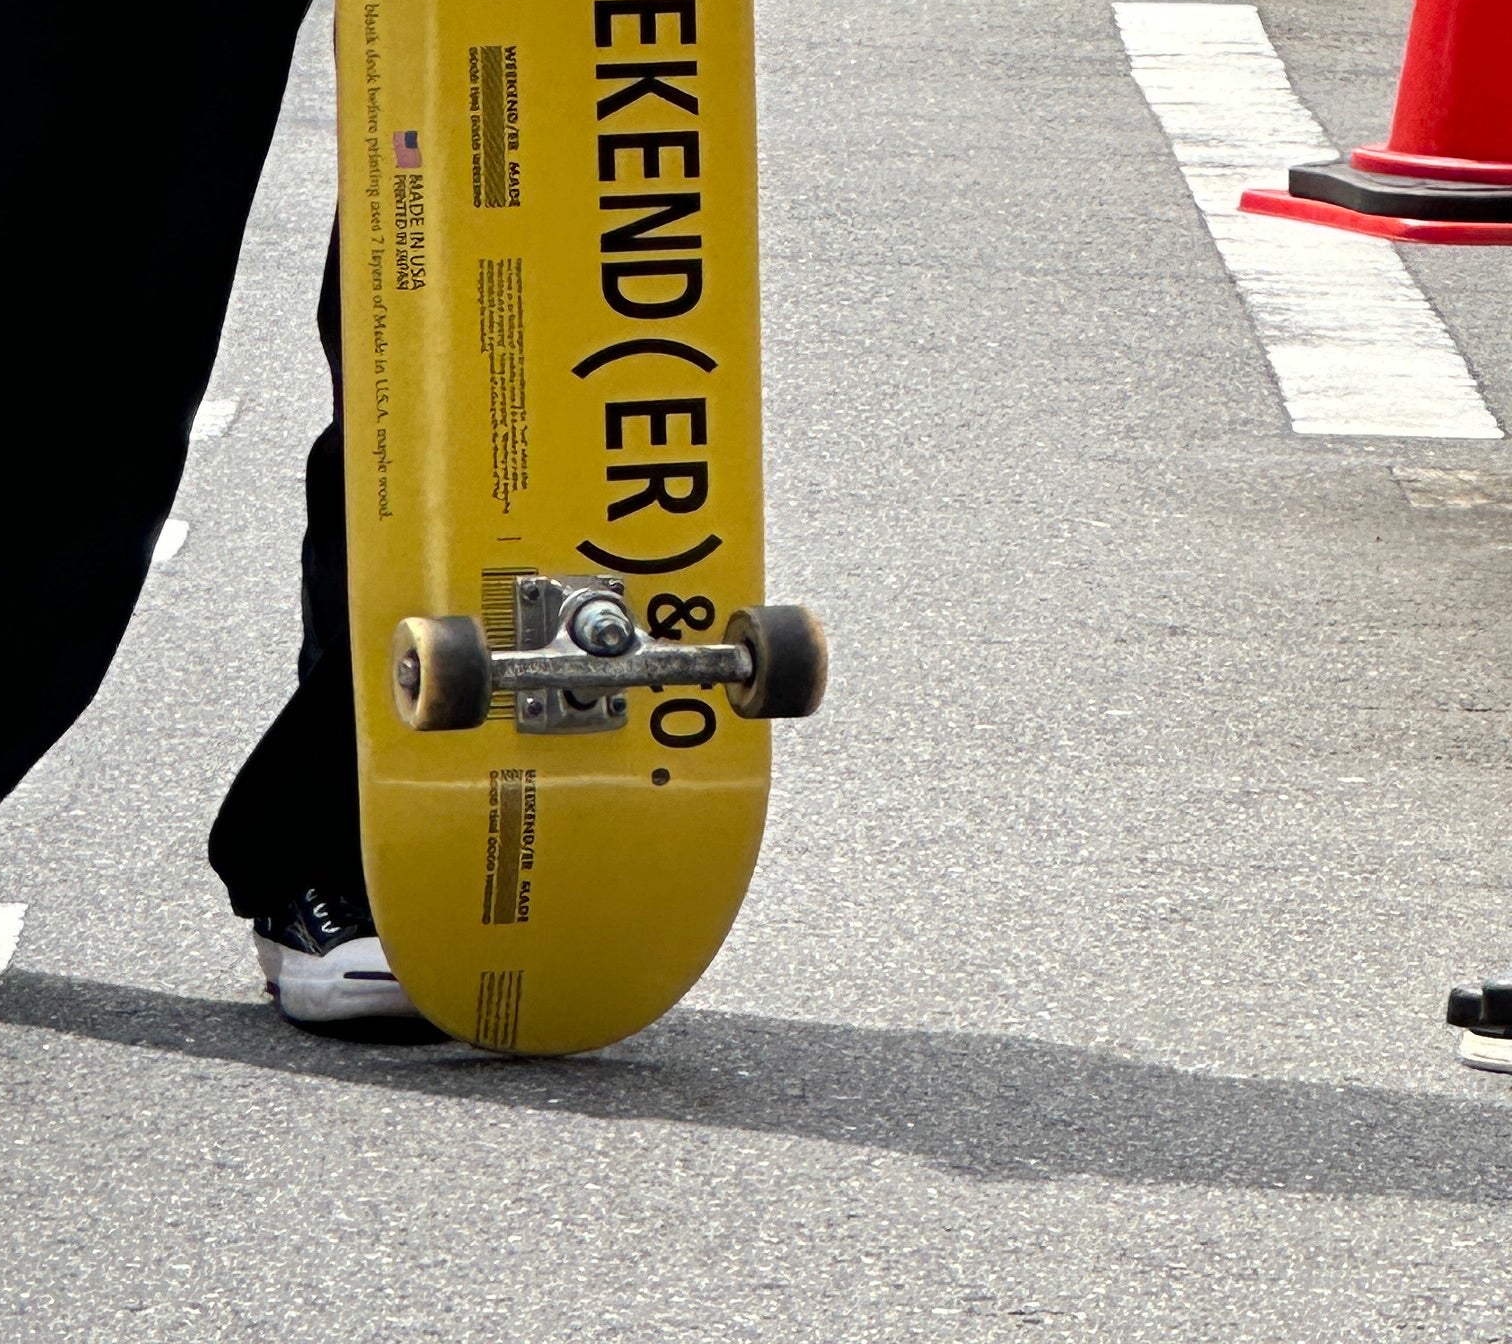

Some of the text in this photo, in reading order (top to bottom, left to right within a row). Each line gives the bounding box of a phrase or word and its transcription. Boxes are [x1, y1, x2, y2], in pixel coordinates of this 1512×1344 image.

[407, 173, 426, 291] MADE IN USA
